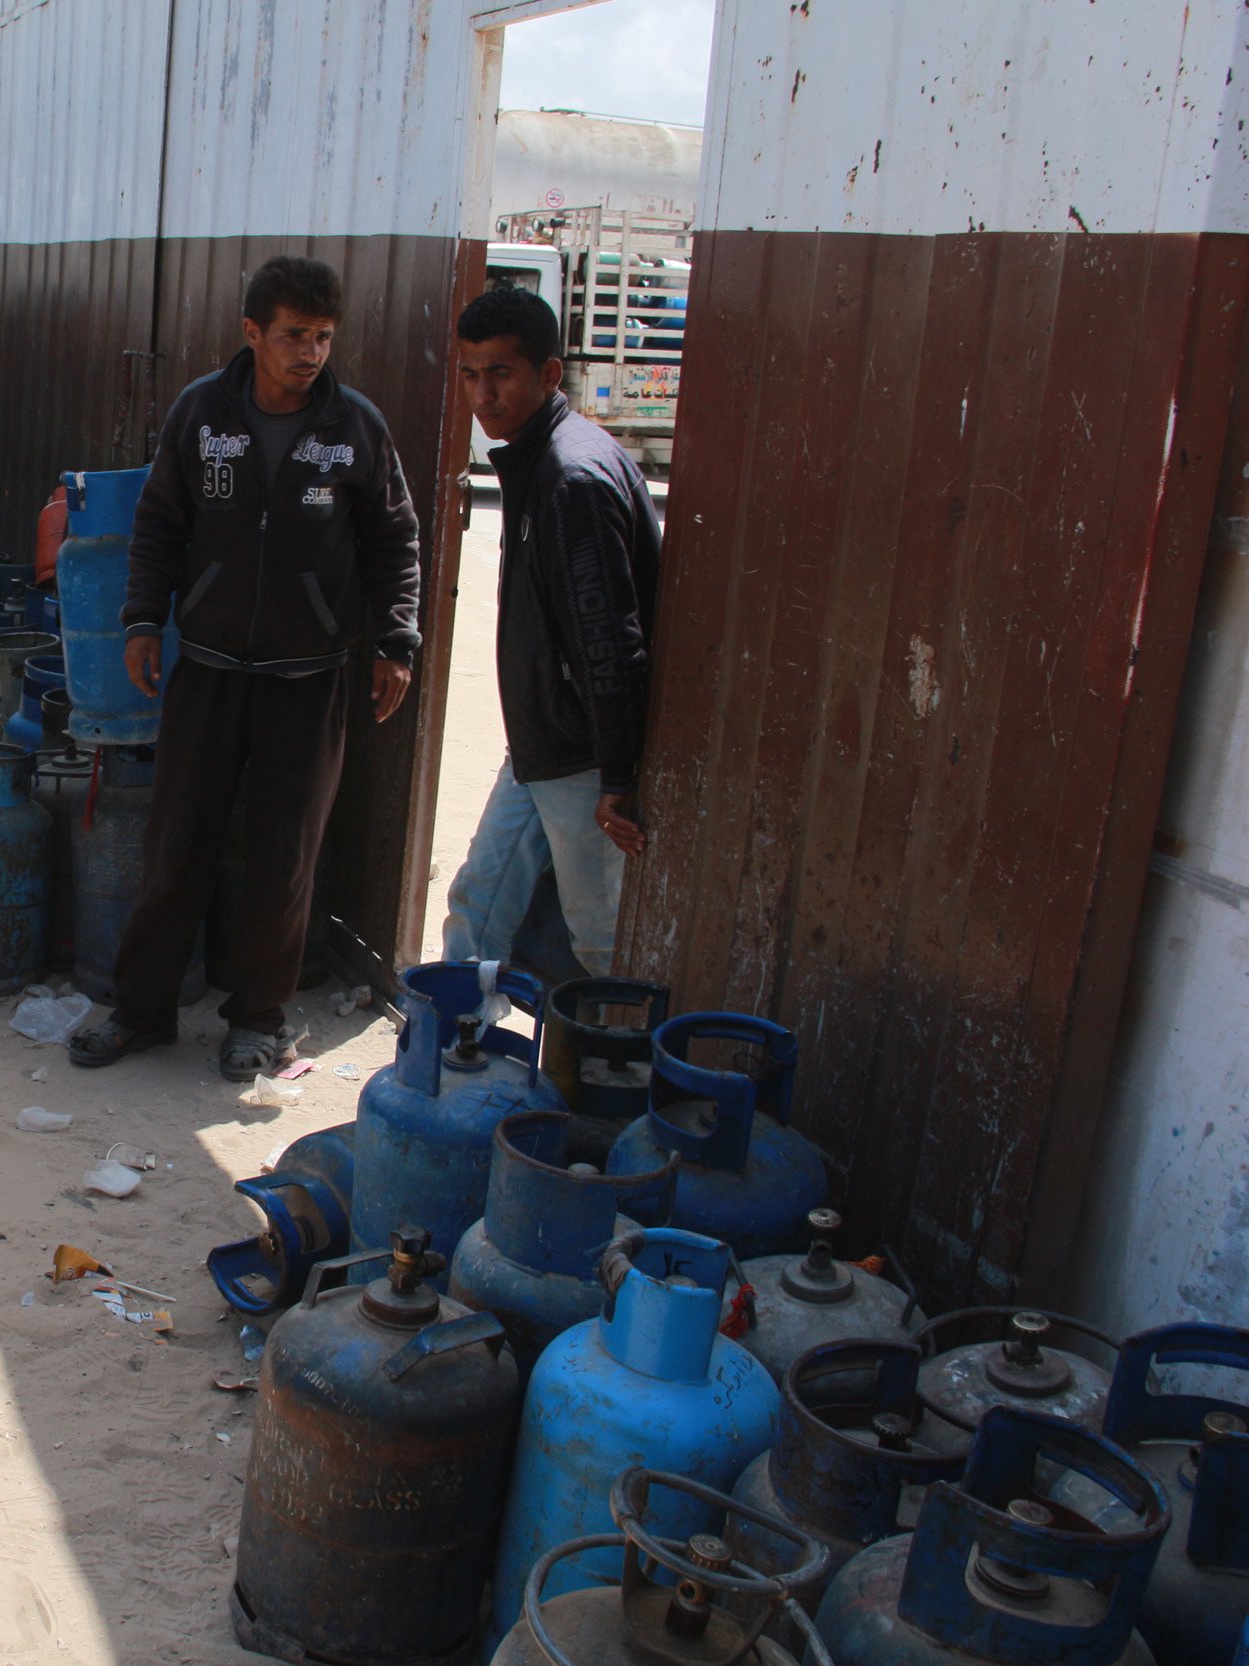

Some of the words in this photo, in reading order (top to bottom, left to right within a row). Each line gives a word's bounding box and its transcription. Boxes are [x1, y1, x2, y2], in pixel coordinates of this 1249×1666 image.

[200, 425, 250, 467] Super
[292, 432, 354, 472] League
[203, 462, 233, 498] 98
